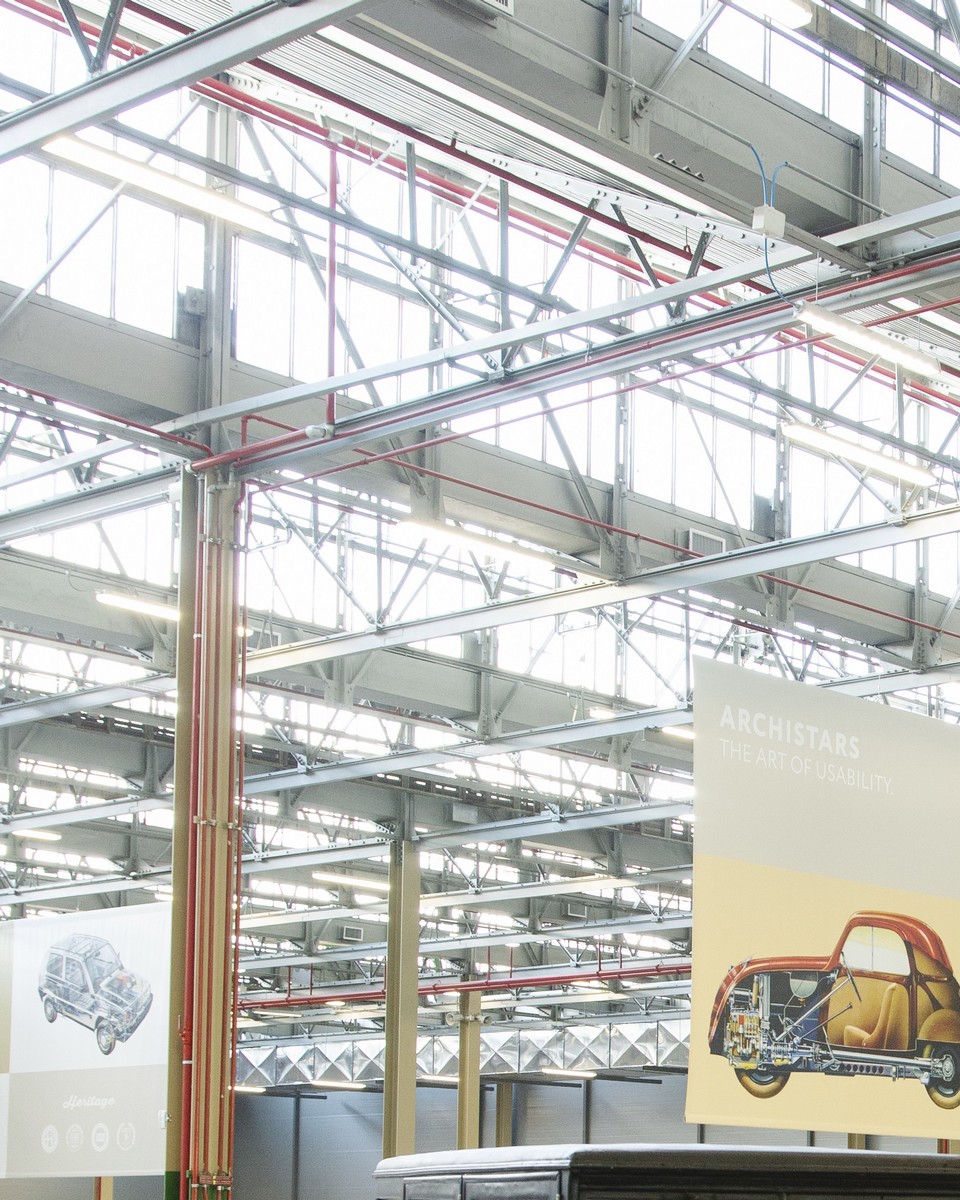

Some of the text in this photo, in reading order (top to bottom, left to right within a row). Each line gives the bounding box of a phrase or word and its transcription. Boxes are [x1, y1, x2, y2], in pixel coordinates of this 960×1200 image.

[719, 704, 861, 760] ARCHISTARS
[719, 738, 895, 796] THE ART OF USABILITY.
[63, 1094, 115, 1110] Heritage
